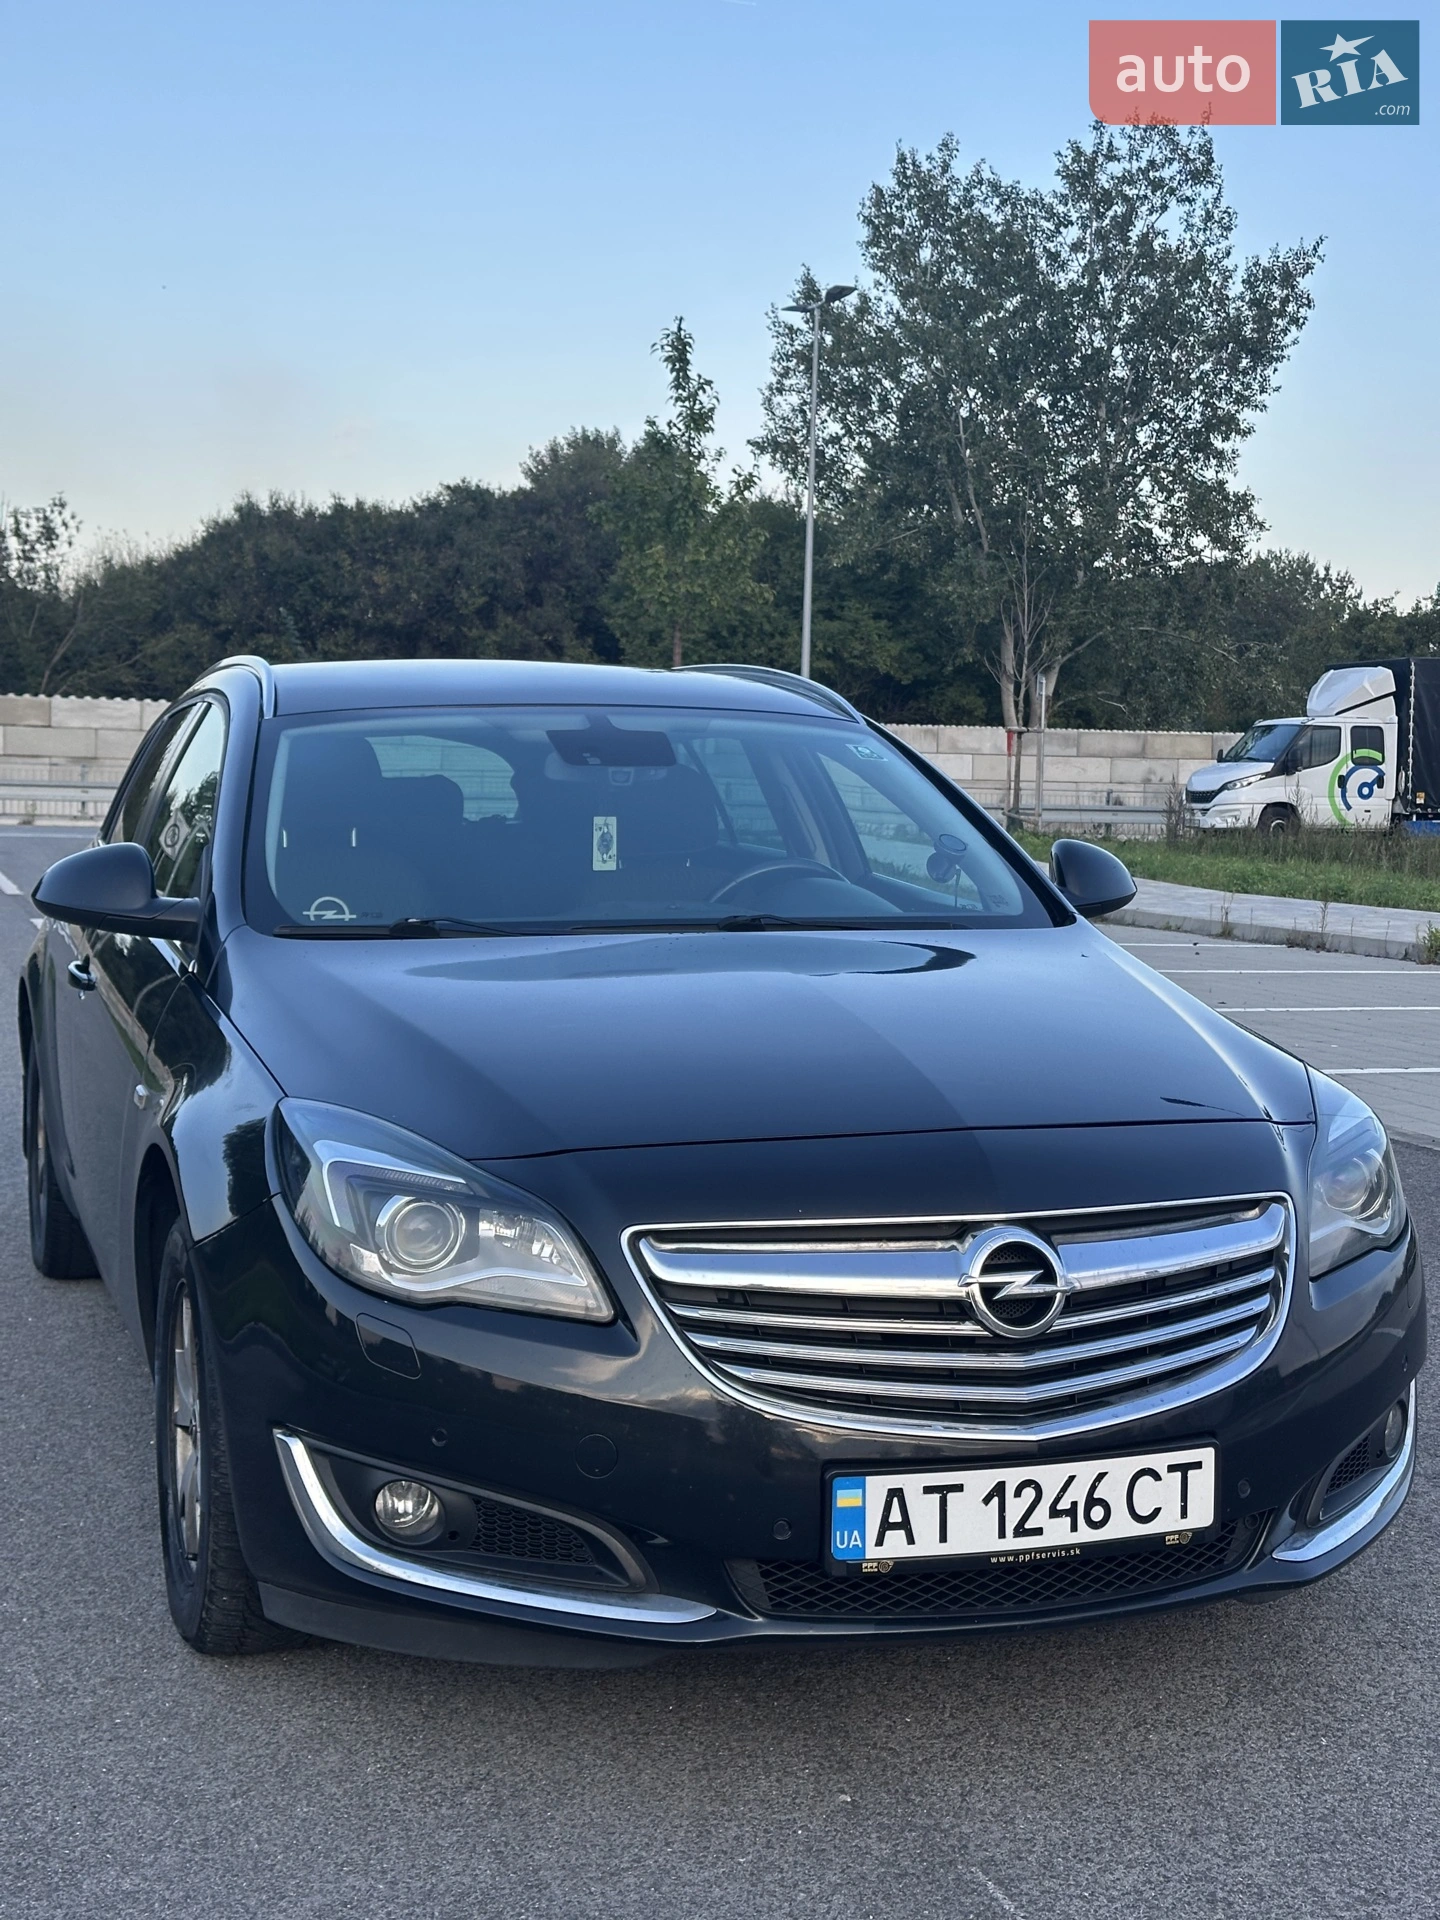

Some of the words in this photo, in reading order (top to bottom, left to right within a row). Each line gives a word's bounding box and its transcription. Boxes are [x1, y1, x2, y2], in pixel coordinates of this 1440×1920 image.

[874, 1483, 964, 1547] AT
[981, 1471, 1112, 1539] 1246
[1126, 1460, 1203, 1525] CT
[836, 1530, 862, 1549] UA
[990, 1547, 1081, 1563] www.ppfservis.sk
